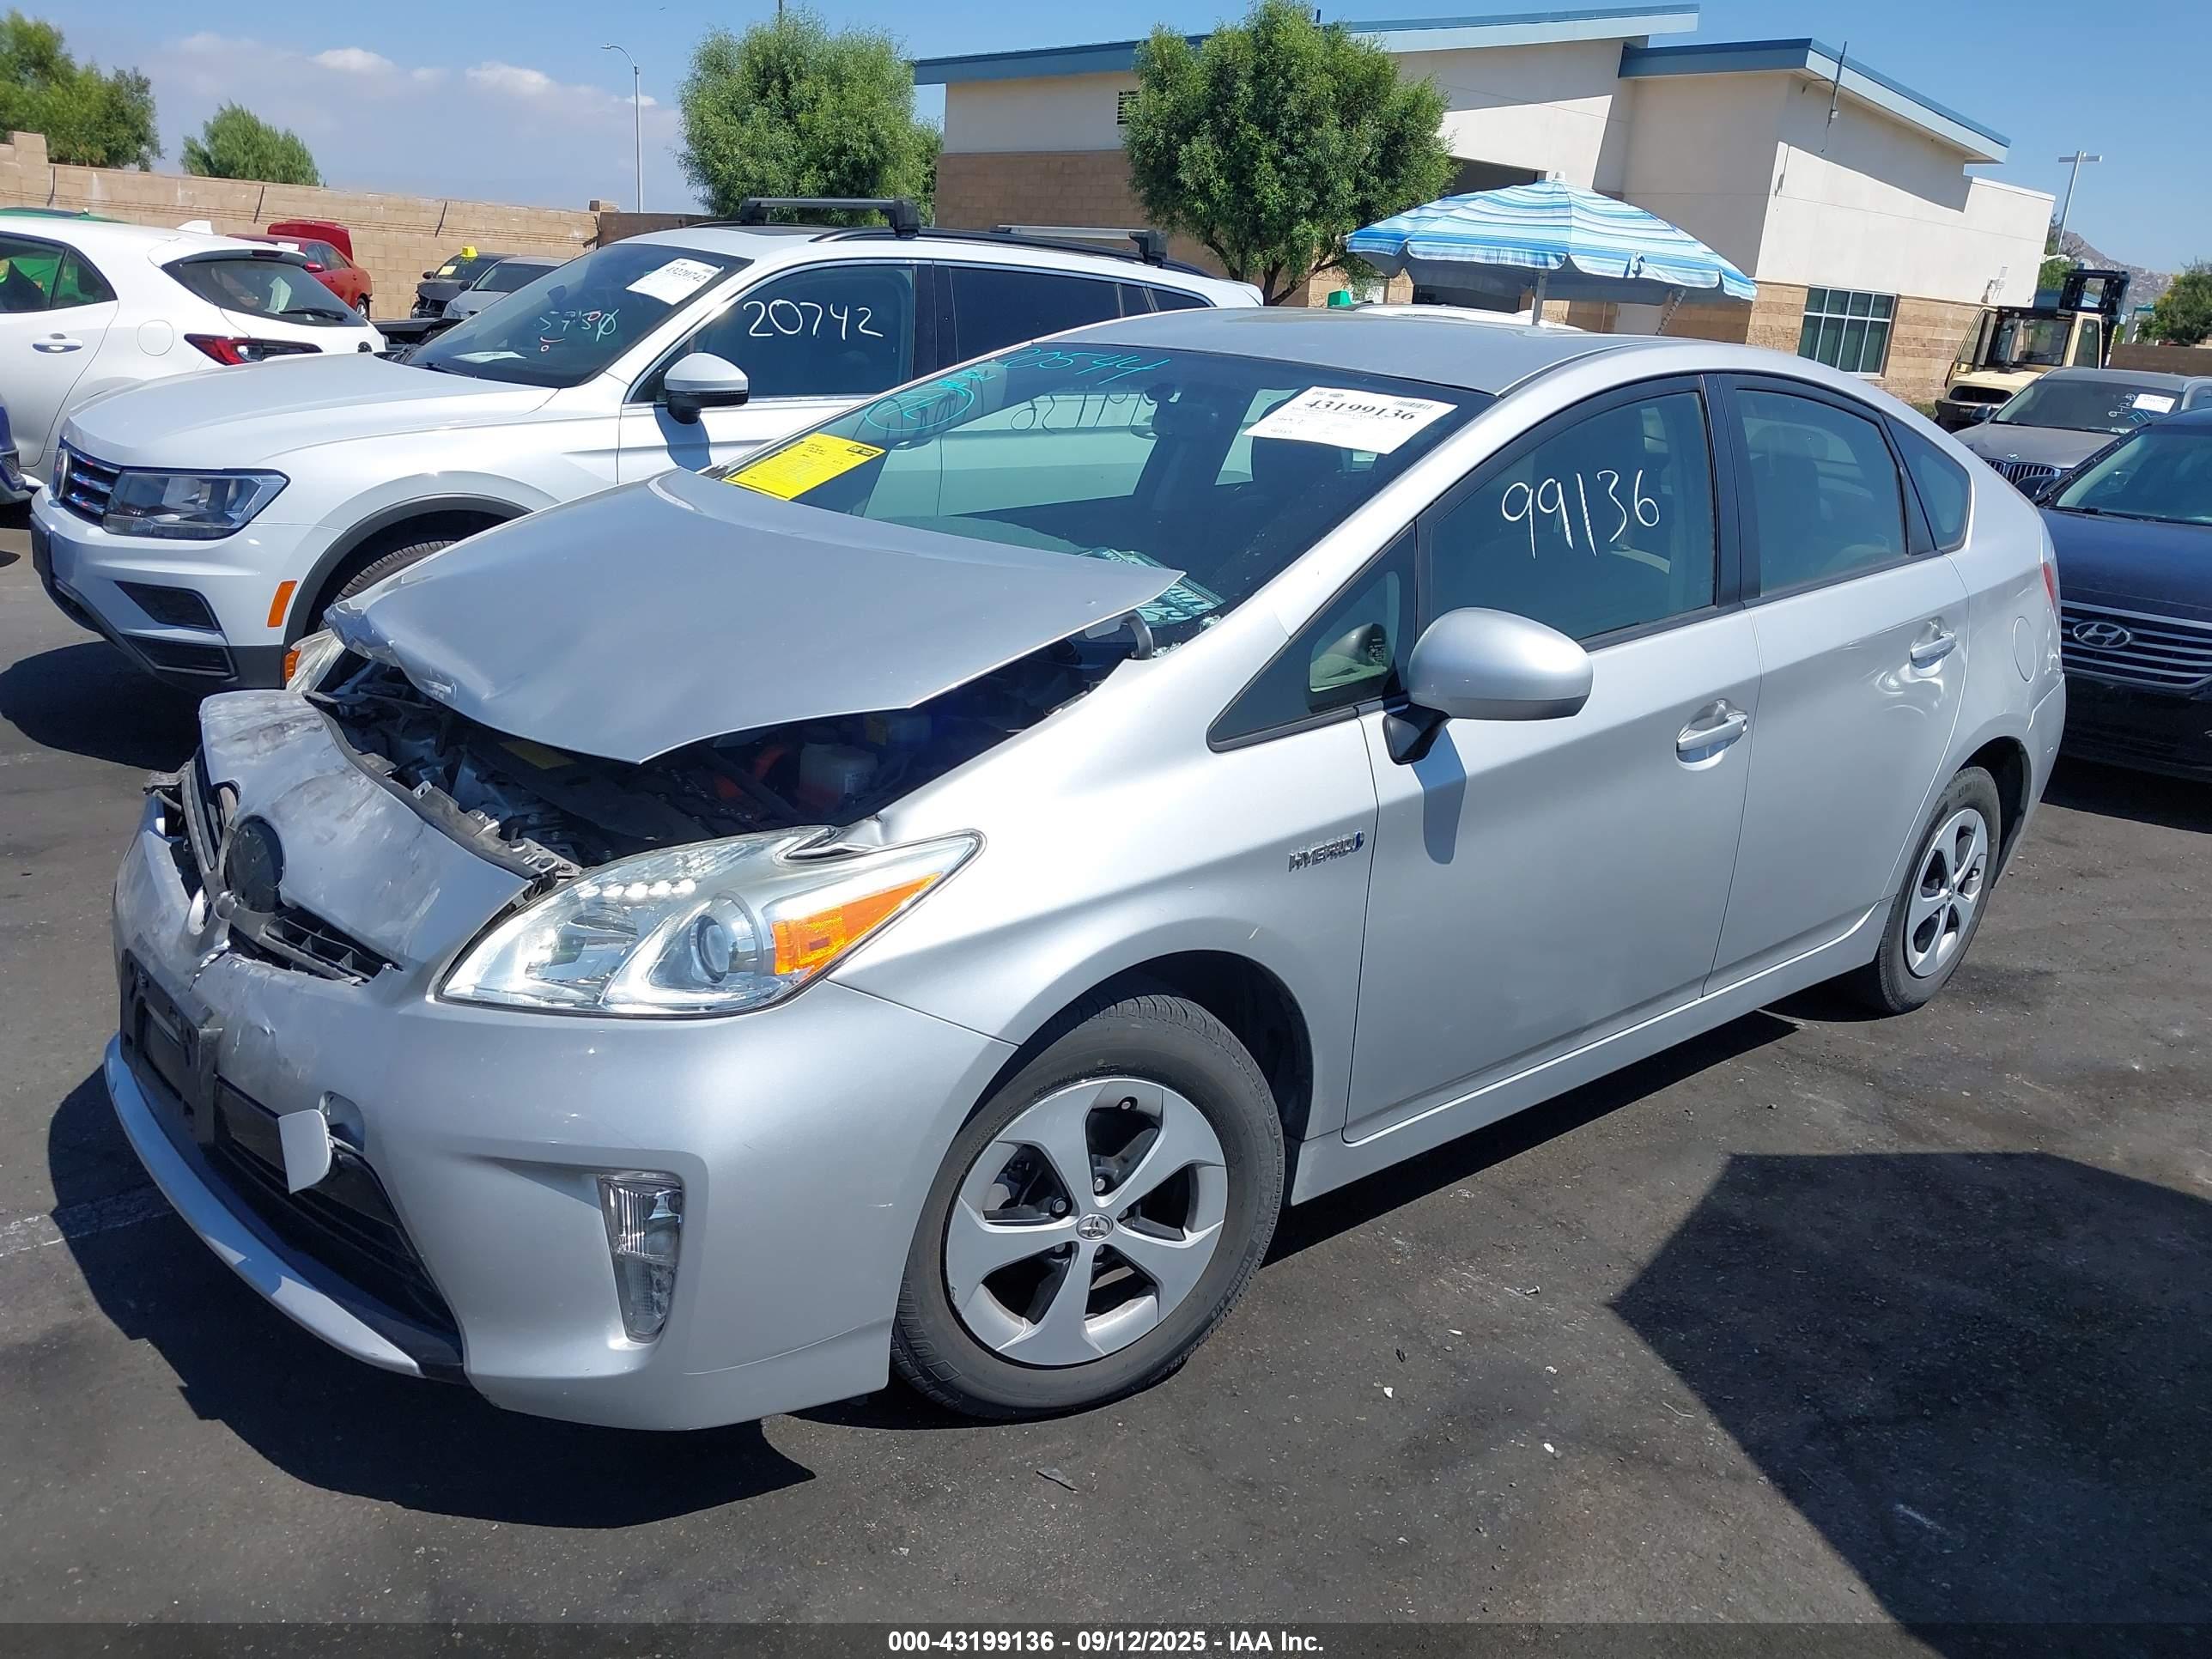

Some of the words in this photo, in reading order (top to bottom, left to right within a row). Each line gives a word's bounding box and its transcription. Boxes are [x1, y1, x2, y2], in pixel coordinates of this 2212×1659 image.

[743, 299, 884, 340] 20742
[1304, 398, 1418, 422] 43199136
[1501, 469, 1661, 561] 99136
[1288, 838, 1356, 872] HYBRID
